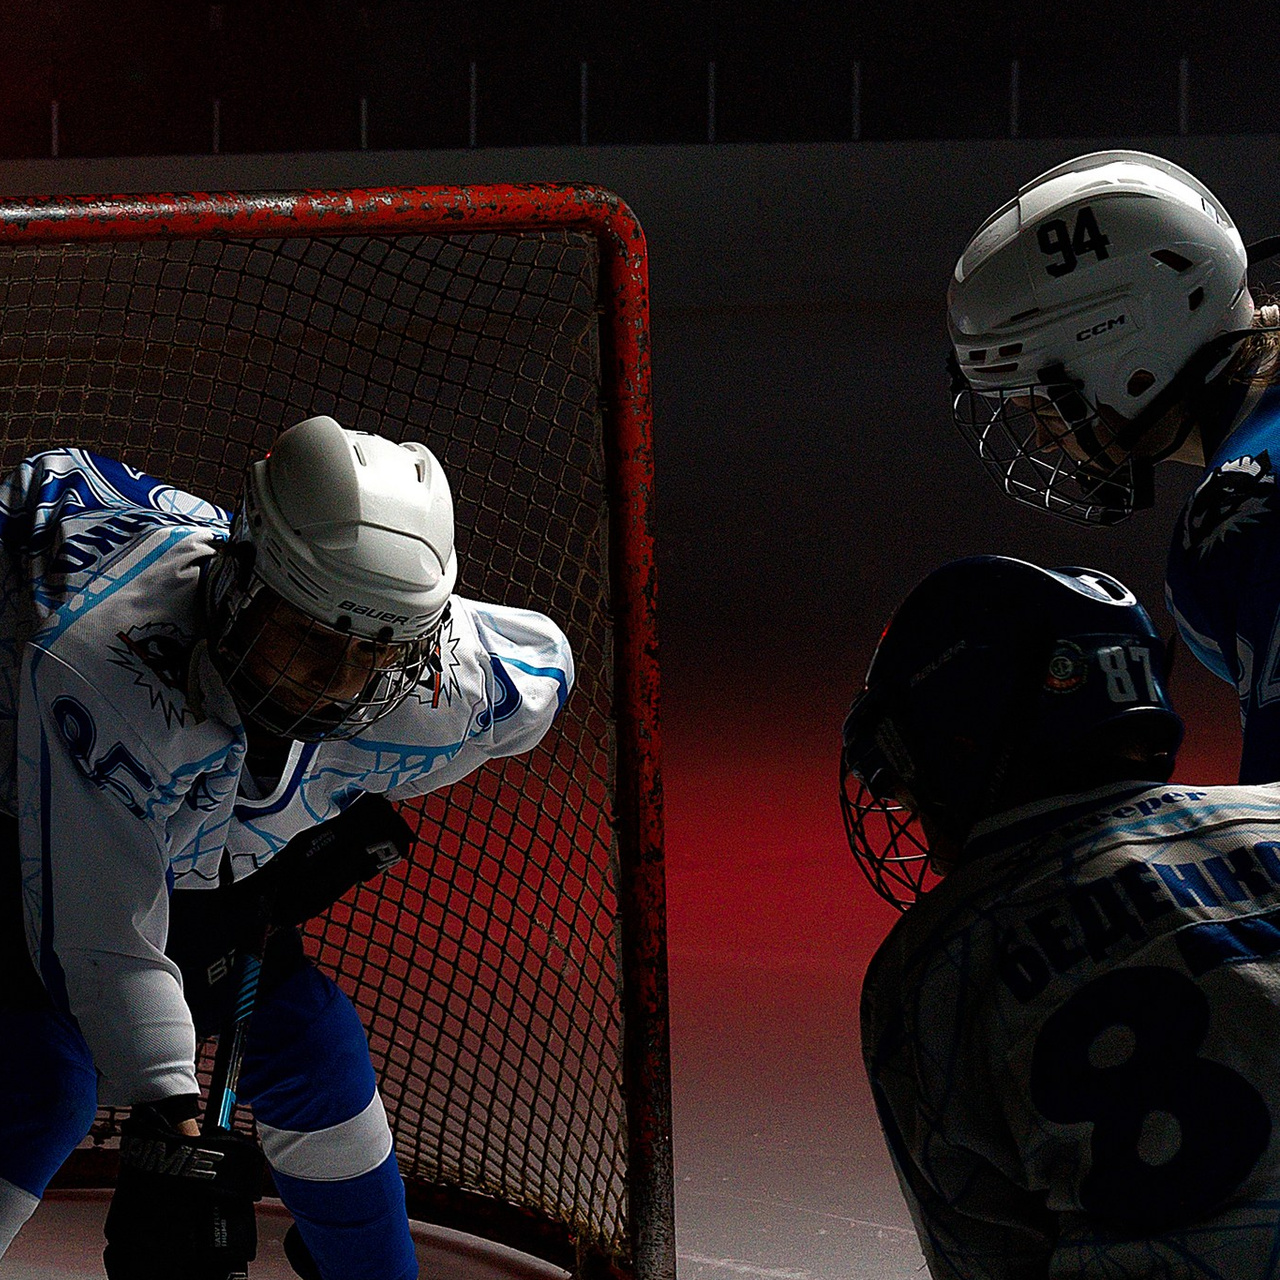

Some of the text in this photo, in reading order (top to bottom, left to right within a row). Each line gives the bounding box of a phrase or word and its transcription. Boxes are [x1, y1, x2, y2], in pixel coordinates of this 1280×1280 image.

[1036, 206, 1110, 278] 94
[1076, 314, 1125, 343] CCM
[338, 600, 410, 626] BAUER
[1097, 644, 1161, 704] 87
